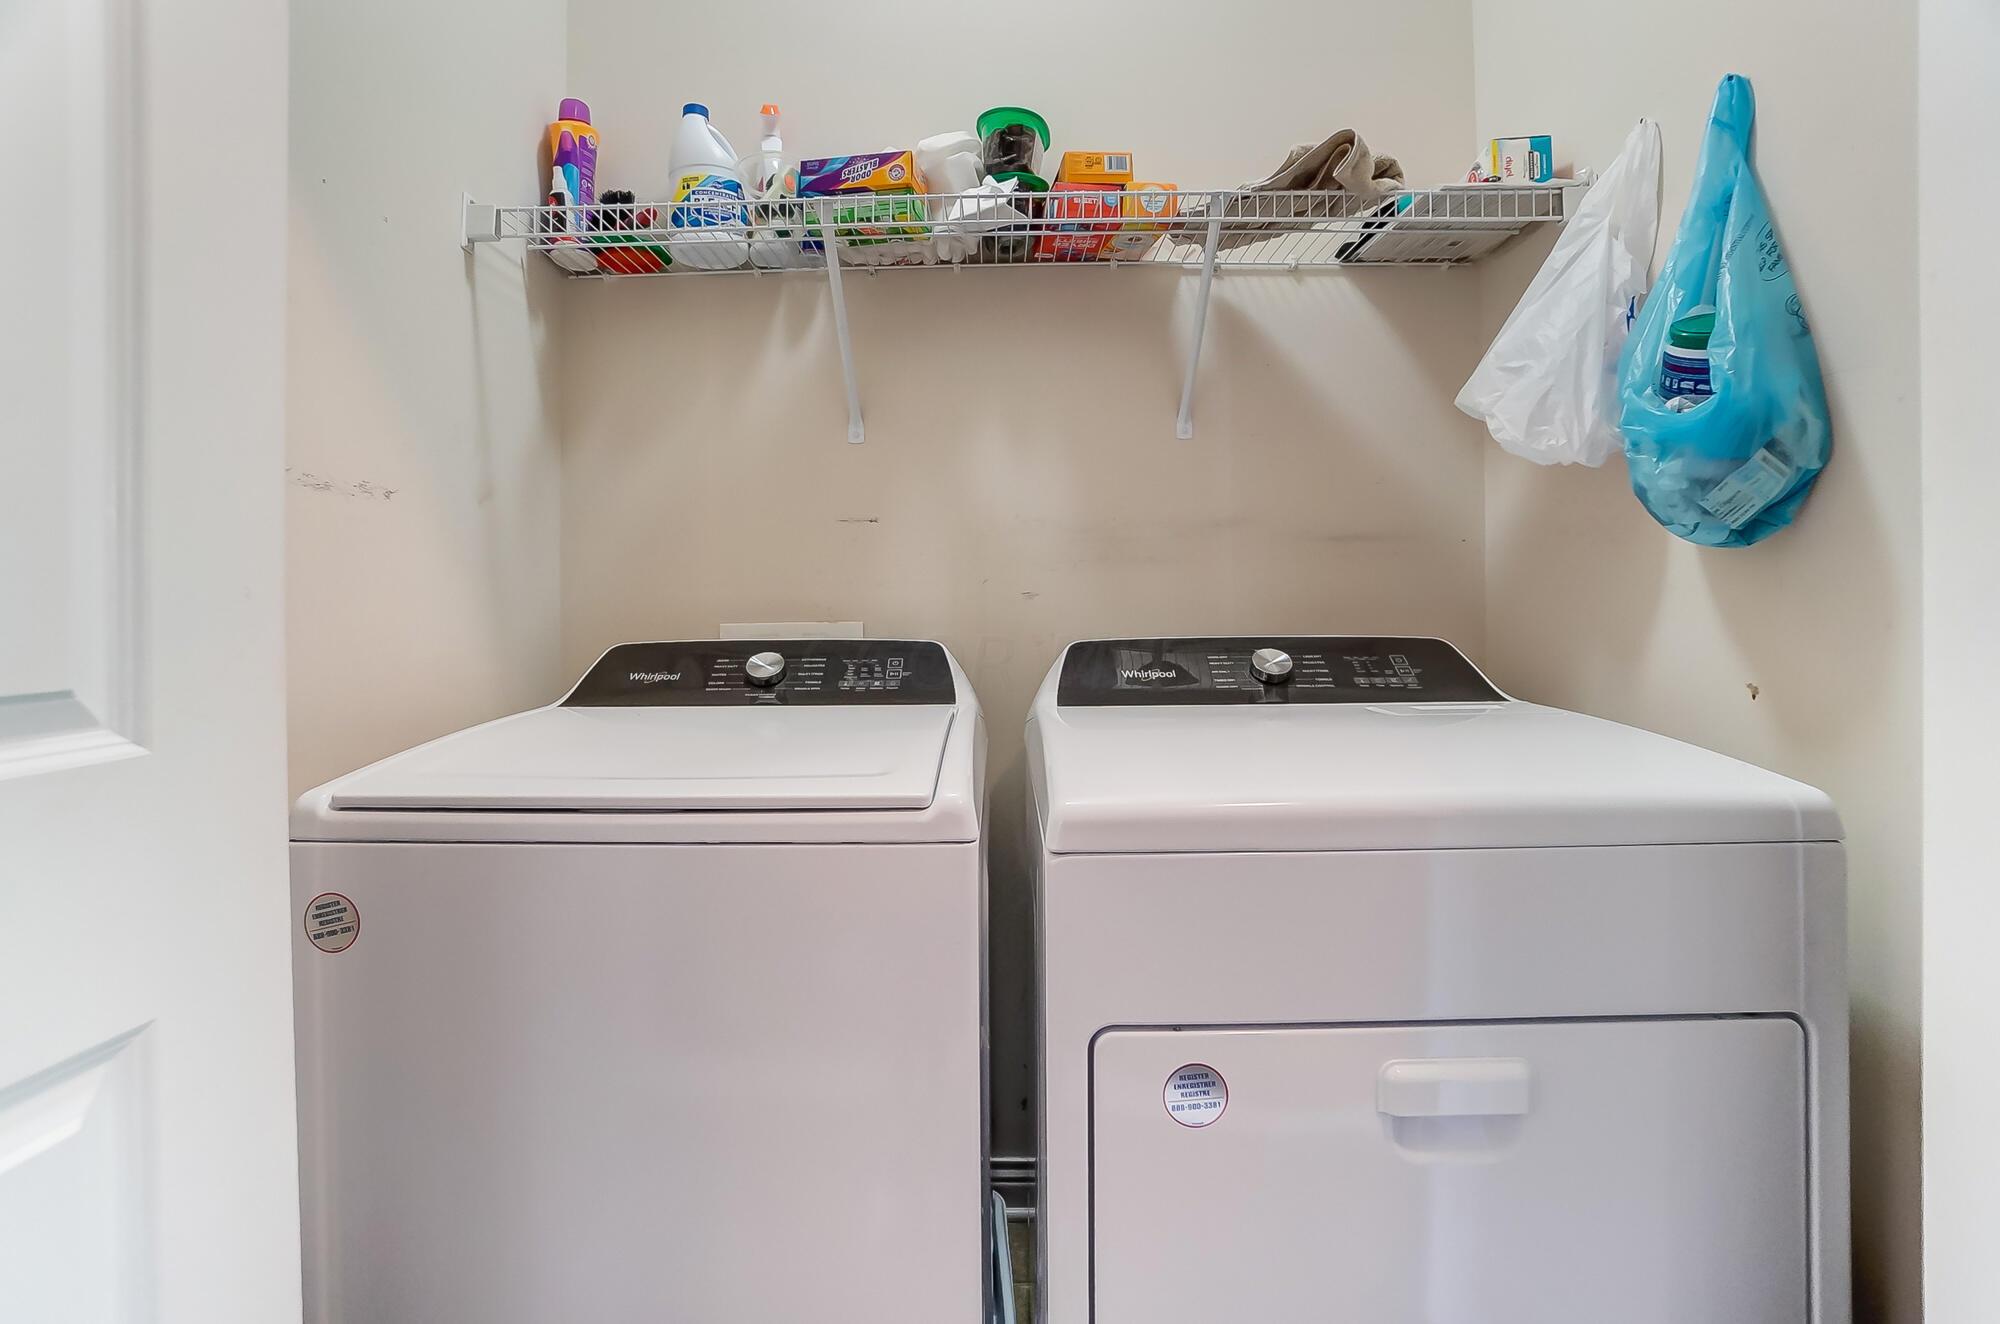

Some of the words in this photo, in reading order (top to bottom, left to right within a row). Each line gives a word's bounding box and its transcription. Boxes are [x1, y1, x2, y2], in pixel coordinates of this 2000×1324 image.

[842, 158, 880, 180] BLASTERS
[850, 169, 872, 183] ODOR
[629, 671, 681, 684] Whirlpool
[1121, 668, 1177, 682] Whirlpool
[1178, 1072, 1210, 1081] REGISTER
[1180, 1090, 1211, 1099] REGISTRE
